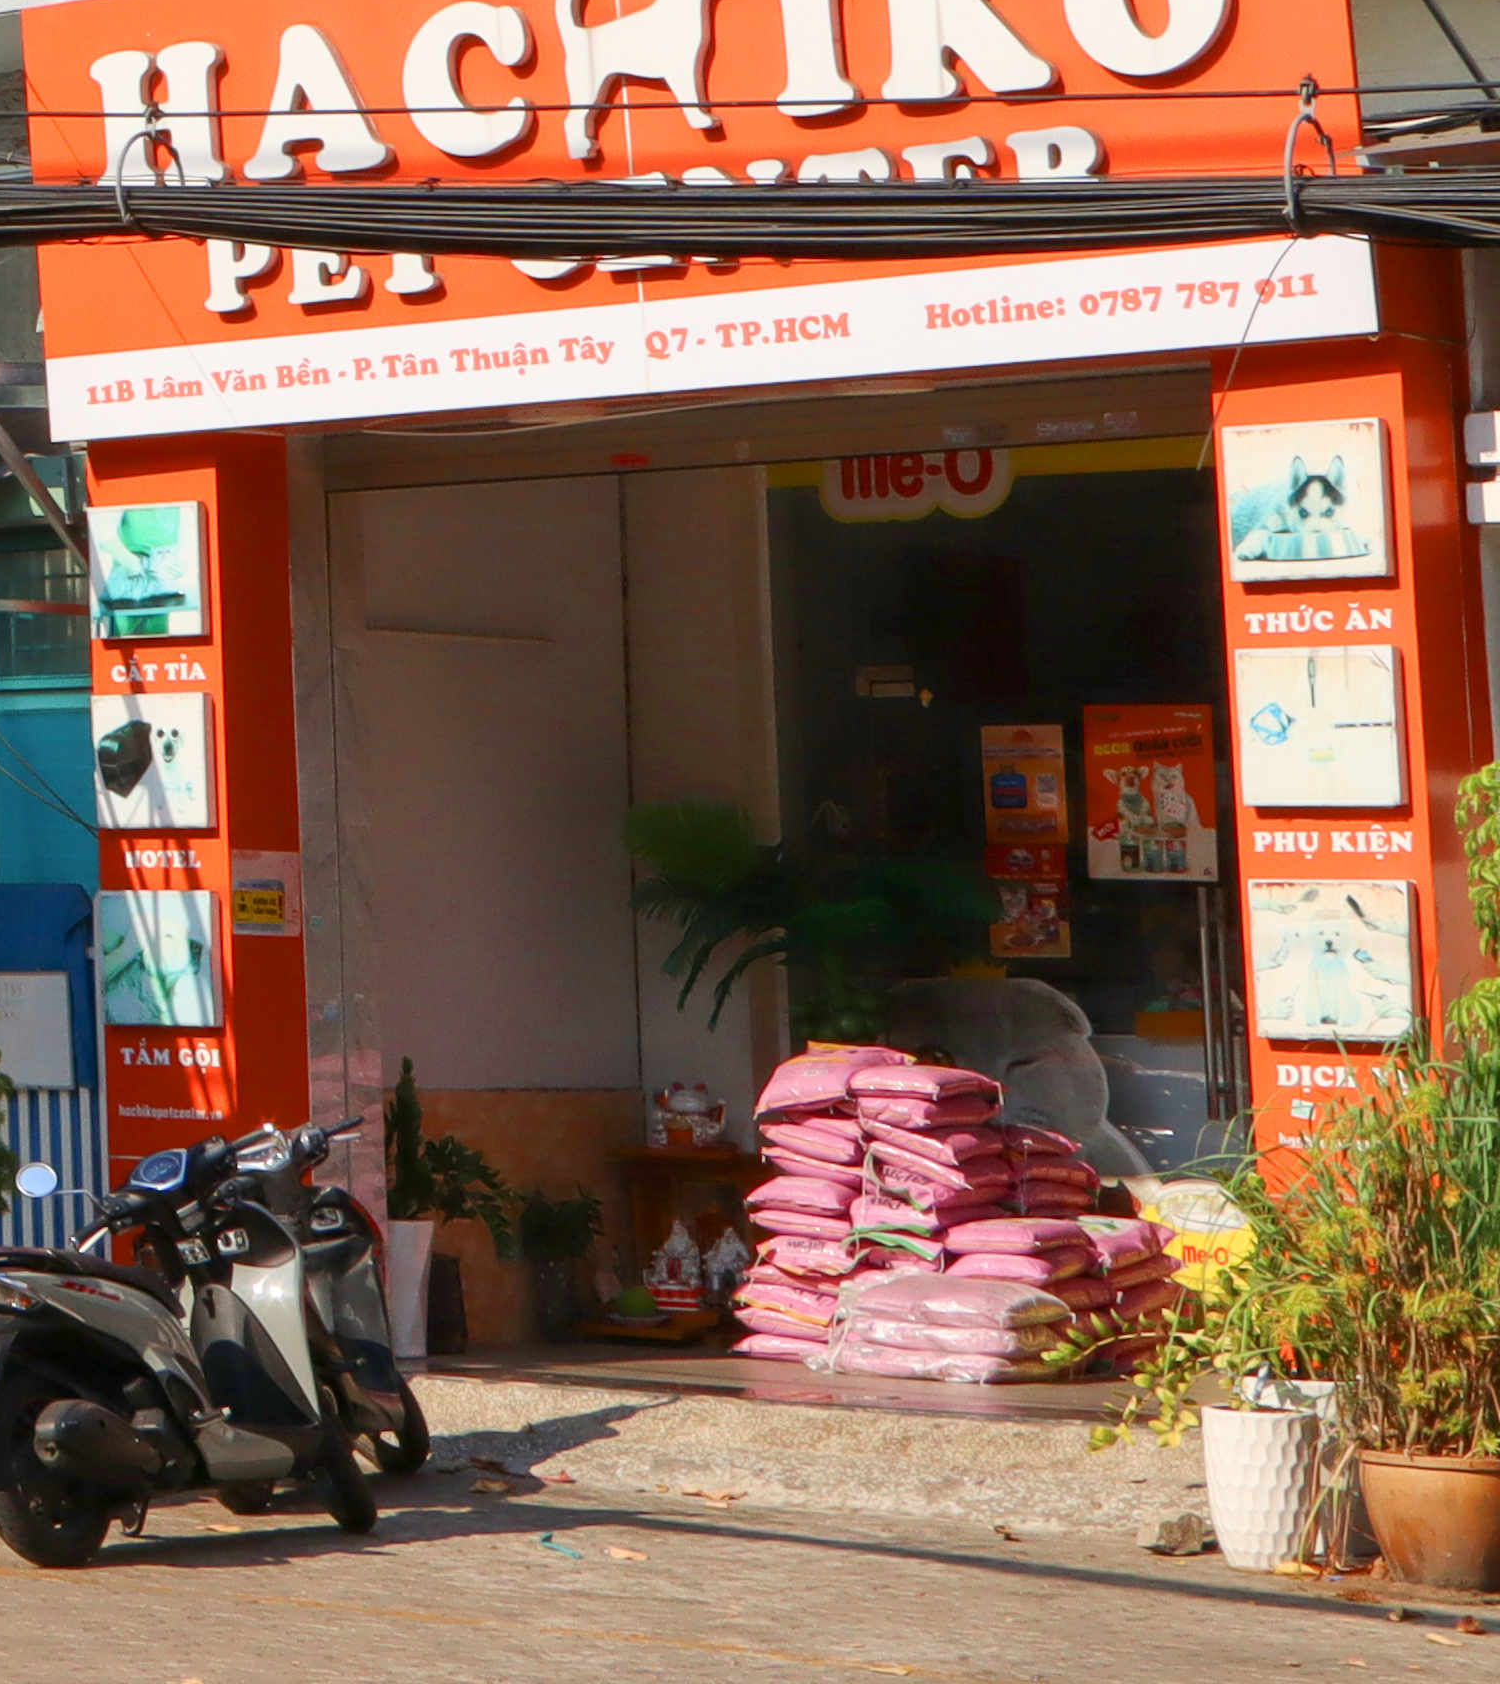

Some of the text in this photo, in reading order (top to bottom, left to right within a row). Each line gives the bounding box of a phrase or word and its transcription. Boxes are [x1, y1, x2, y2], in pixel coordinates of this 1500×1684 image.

[86, 380, 135, 405] 11B
[144, 375, 203, 400] Lâm
[212, 367, 266, 394] Văn
[276, 362, 331, 389] Bền
[353, 358, 377, 381] P.
[382, 352, 439, 378] Tân
[449, 341, 550, 376] Thuận
[558, 335, 616, 364] Tây
[644, 328, 688, 359] Q7
[716, 312, 851, 348] TP.HCM
[925, 296, 1066, 330] Hotline:
[1079, 286, 1163, 317] 0787
[1175, 281, 1240, 309] 787
[1254, 273, 1319, 305] 911
[1244, 601, 1393, 634] THỨC ĂN
[110, 652, 207, 684] CẮT TỈA
[1252, 824, 1414, 860] PHỤ KIỆN
[125, 849, 202, 869] HOTEL
[120, 1037, 221, 1074] TẮM GỘI
[1182, 1244, 1229, 1265] Me-O
